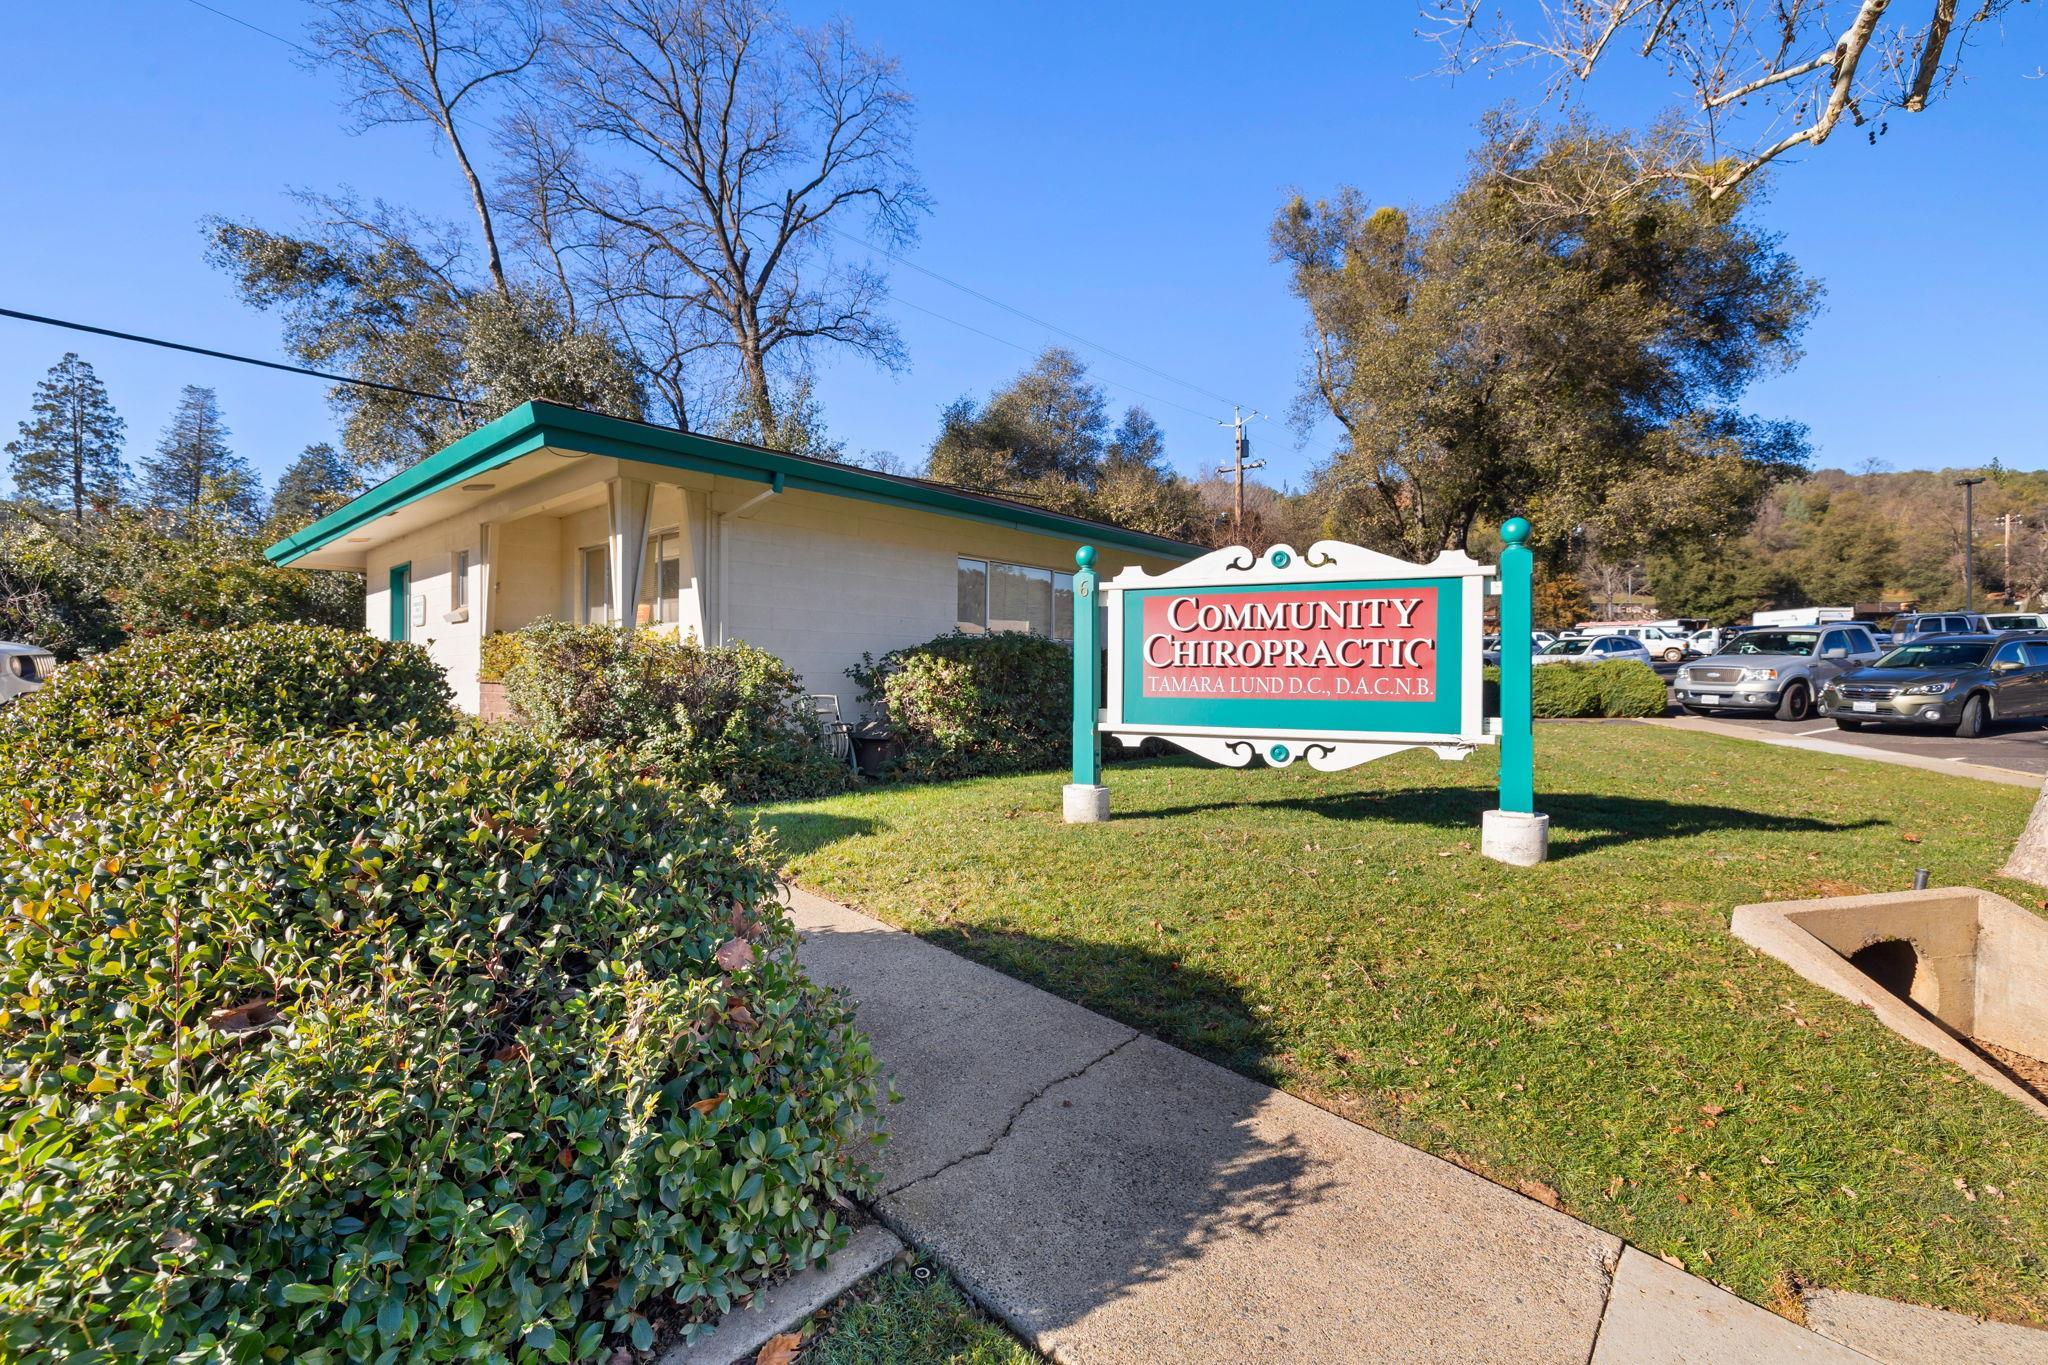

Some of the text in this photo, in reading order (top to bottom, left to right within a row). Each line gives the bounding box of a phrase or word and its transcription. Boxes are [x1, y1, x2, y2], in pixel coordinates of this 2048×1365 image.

[1080, 580, 1089, 598] 6
[1167, 596, 1423, 632] COMMUNITY
[1143, 633, 1435, 669] CHIROPRACTIC
[1147, 676, 1435, 696] TAMARA LUND D.C., D.A.C.N.B.
